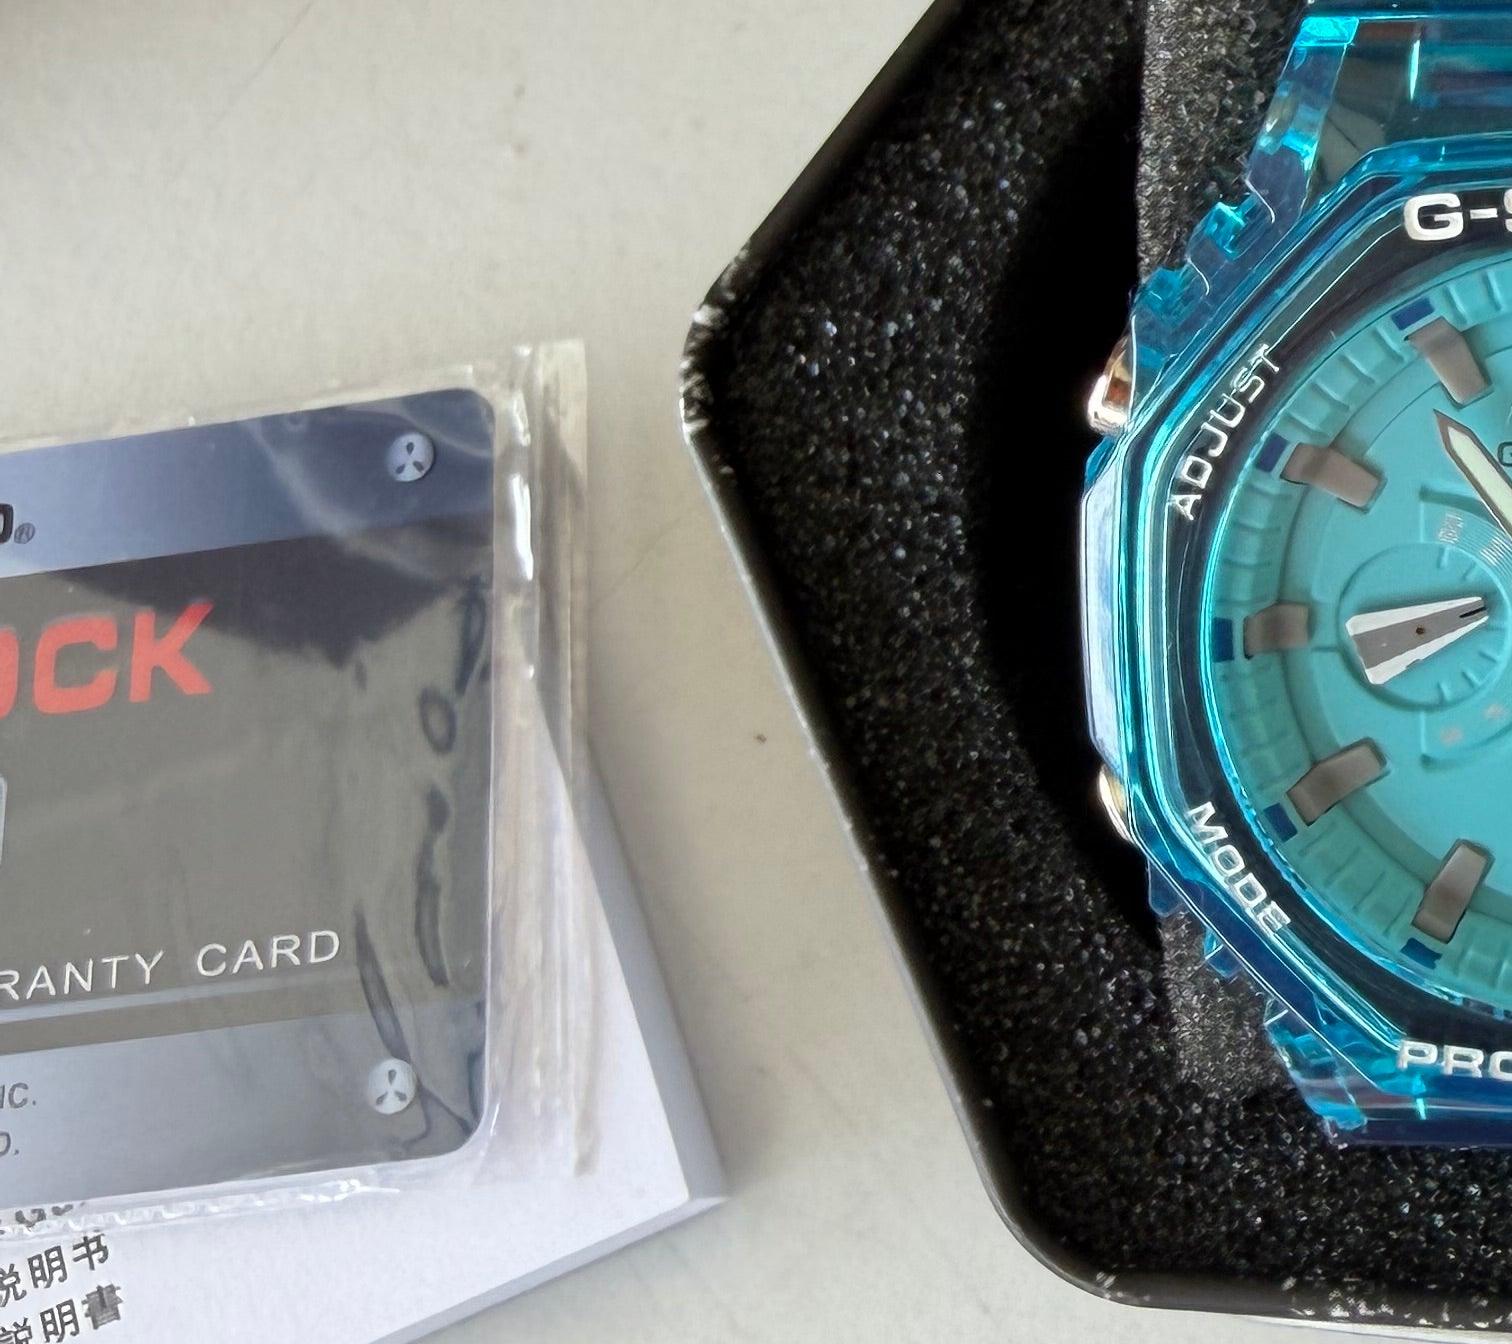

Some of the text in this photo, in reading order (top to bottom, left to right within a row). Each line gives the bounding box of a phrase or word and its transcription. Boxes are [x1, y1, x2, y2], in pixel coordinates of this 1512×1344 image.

[1168, 343, 1281, 522] ADJUST
[0, 599, 215, 721] CK
[1185, 800, 1292, 937] MODE
[196, 929, 341, 977] CARD
